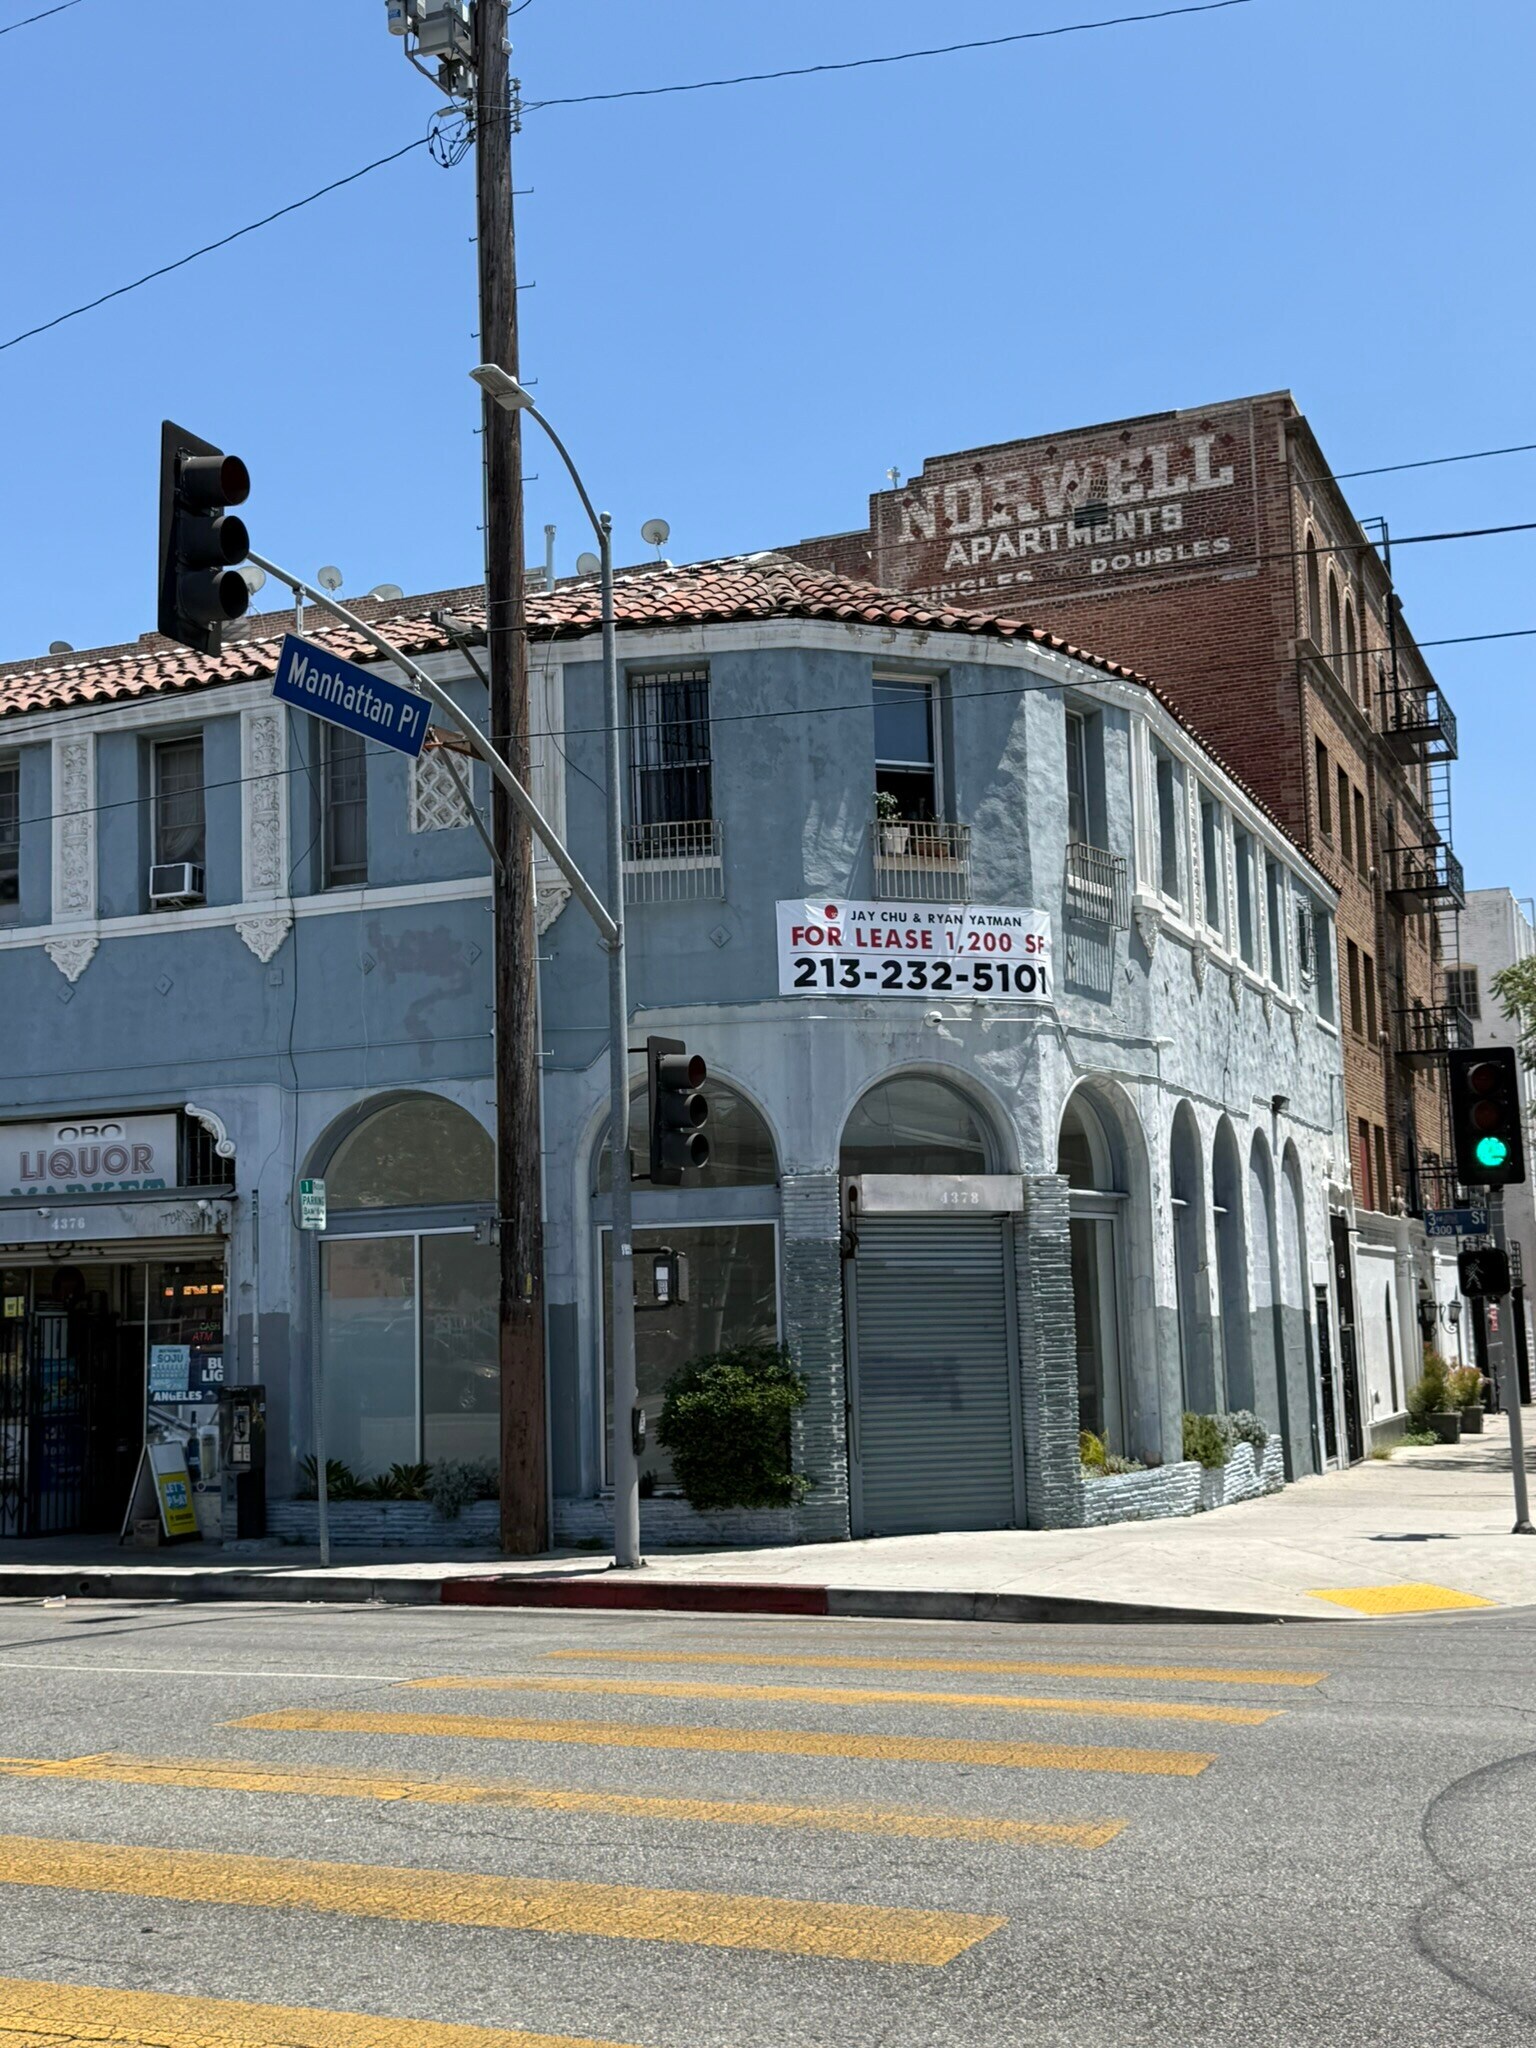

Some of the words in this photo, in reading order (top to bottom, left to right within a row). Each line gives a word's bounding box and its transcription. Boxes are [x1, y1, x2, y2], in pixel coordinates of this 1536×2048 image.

[898, 435, 1234, 544] NORWELL
[944, 503, 1183, 570] APARTMENTS
[1091, 537, 1232, 574] DOUBLES
[287, 652, 394, 728] Manhattan
[397, 704, 420, 738] Pl
[851, 910, 875, 922] JAY
[881, 911, 907, 923] CHU
[913, 913, 921, 923] &
[928, 914, 963, 925] RYAN
[969, 915, 1022, 927] YATMAN
[792, 926, 842, 946] FOR
[856, 928, 933, 949] LEASE
[947, 931, 1012, 954] 1,200
[1025, 934, 1044, 954] SF
[794, 957, 1046, 994] 213-232-5101
[20, 1143, 154, 1181] LIQUOR
[940, 1191, 979, 1204] 4378
[1471, 1211, 1486, 1225] St
[1429, 1225, 1452, 1235] 4300
[192, 1331, 214, 1341] ATM
[157, 1353, 184, 1364] SOJU
[202, 1369, 224, 1382] LIG
[153, 1390, 203, 1402] ANGELES
